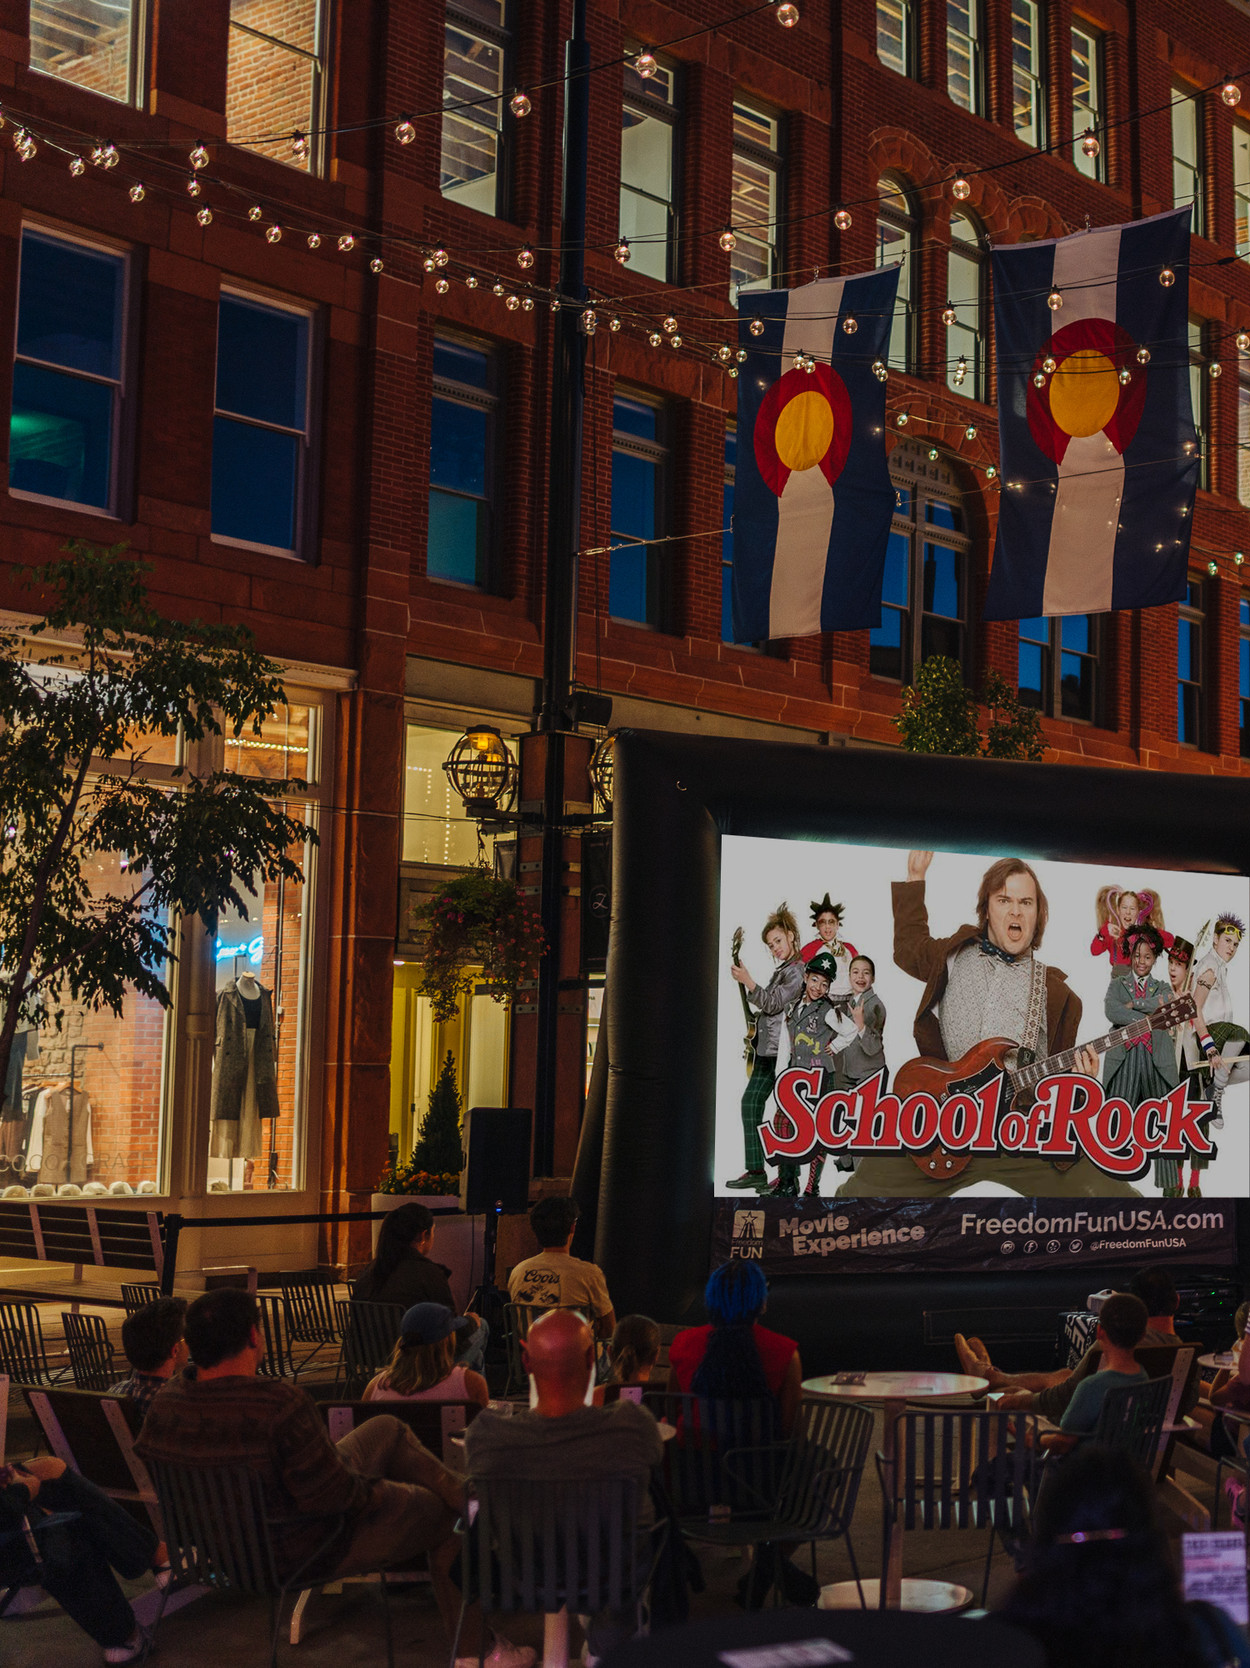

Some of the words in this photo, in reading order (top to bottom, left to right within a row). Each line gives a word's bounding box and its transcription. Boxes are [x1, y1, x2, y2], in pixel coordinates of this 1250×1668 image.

[760, 1066, 1003, 1161] School
[999, 1102, 1052, 1152] of
[1035, 1072, 1216, 1176] Rock
[779, 1212, 849, 1237] Movie
[960, 1210, 1224, 1235] FreedomFunUSA.com
[731, 1238, 763, 1246] Freedom
[792, 1225, 926, 1257] Experience
[1090, 1238, 1187, 1251] @FreedomFunUSA
[730, 1247, 763, 1259] FUN
[524, 1269, 560, 1284] Coors
